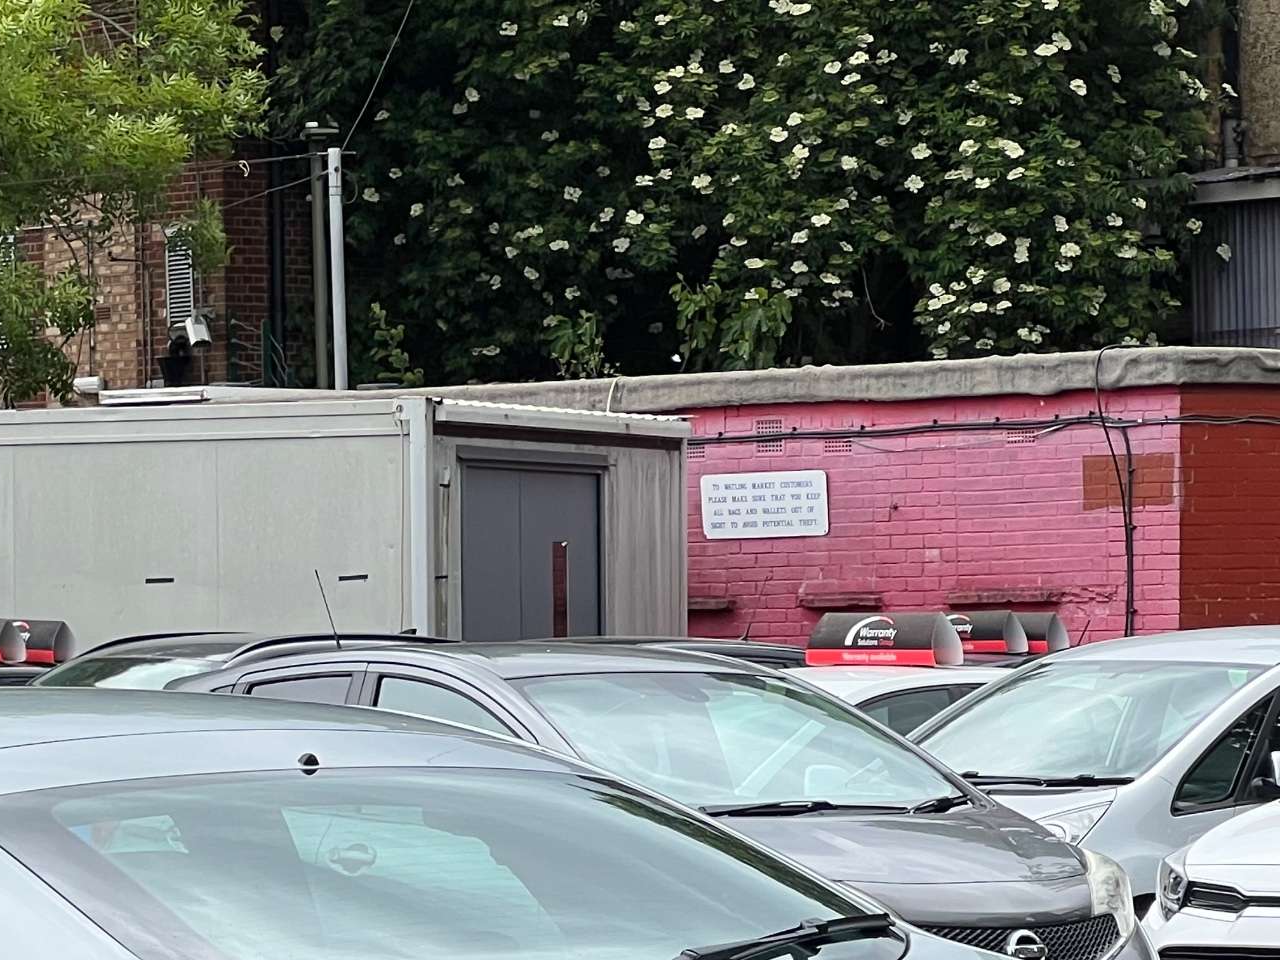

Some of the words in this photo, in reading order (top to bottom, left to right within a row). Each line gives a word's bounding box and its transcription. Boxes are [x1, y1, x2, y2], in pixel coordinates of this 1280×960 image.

[806, 492, 821, 500] KEEP
[762, 520, 794, 528] POTENTIAL
[860, 627, 897, 639] Warranty
[857, 638, 878, 646] Solutions
